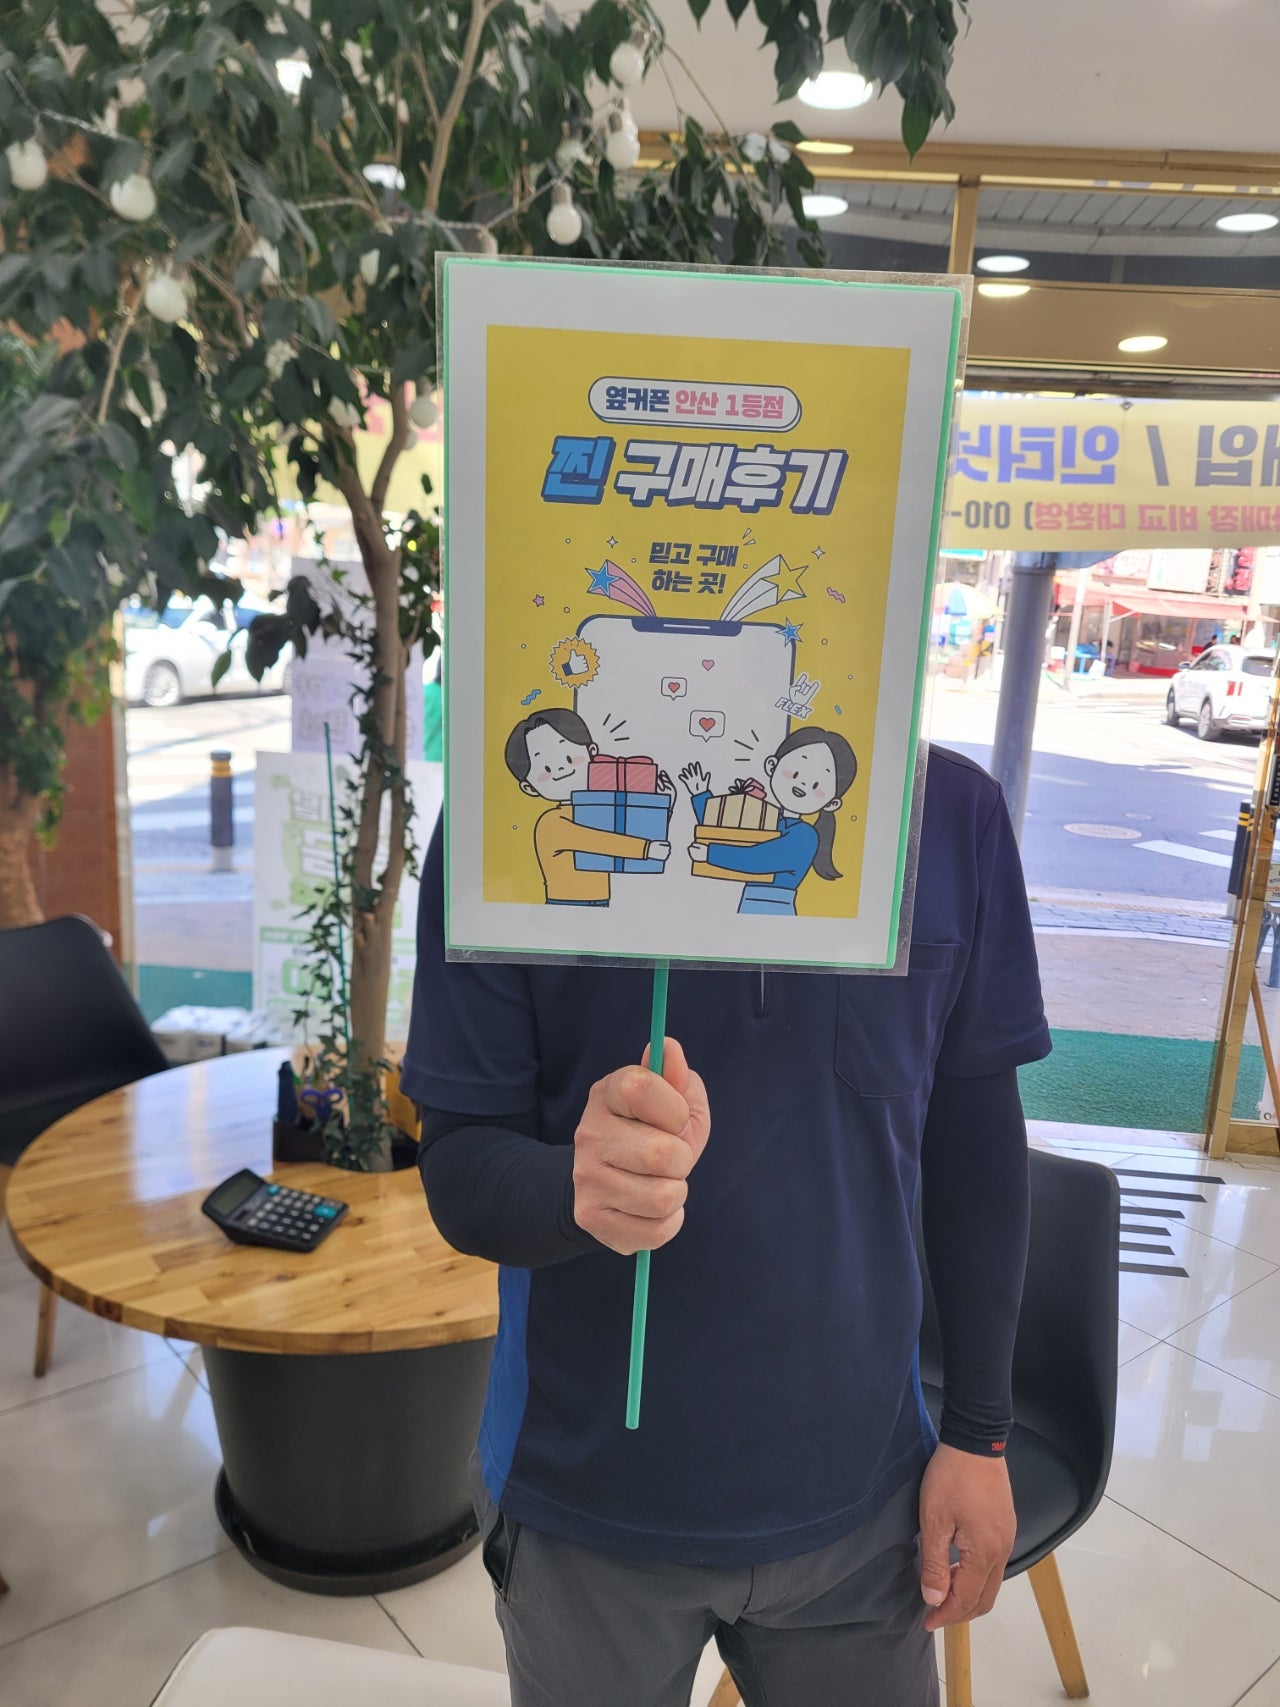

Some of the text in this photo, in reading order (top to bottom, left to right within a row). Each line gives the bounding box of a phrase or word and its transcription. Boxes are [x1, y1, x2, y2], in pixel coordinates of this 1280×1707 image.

[606, 385, 785, 420] 옆커폰 안산 1등점
[541, 435, 849, 515] 찐 구매후기
[649, 542, 740, 567] 믿고 구매
[651, 568, 727, 595] 하는 곳!
[774, 696, 813, 720] FLEX
